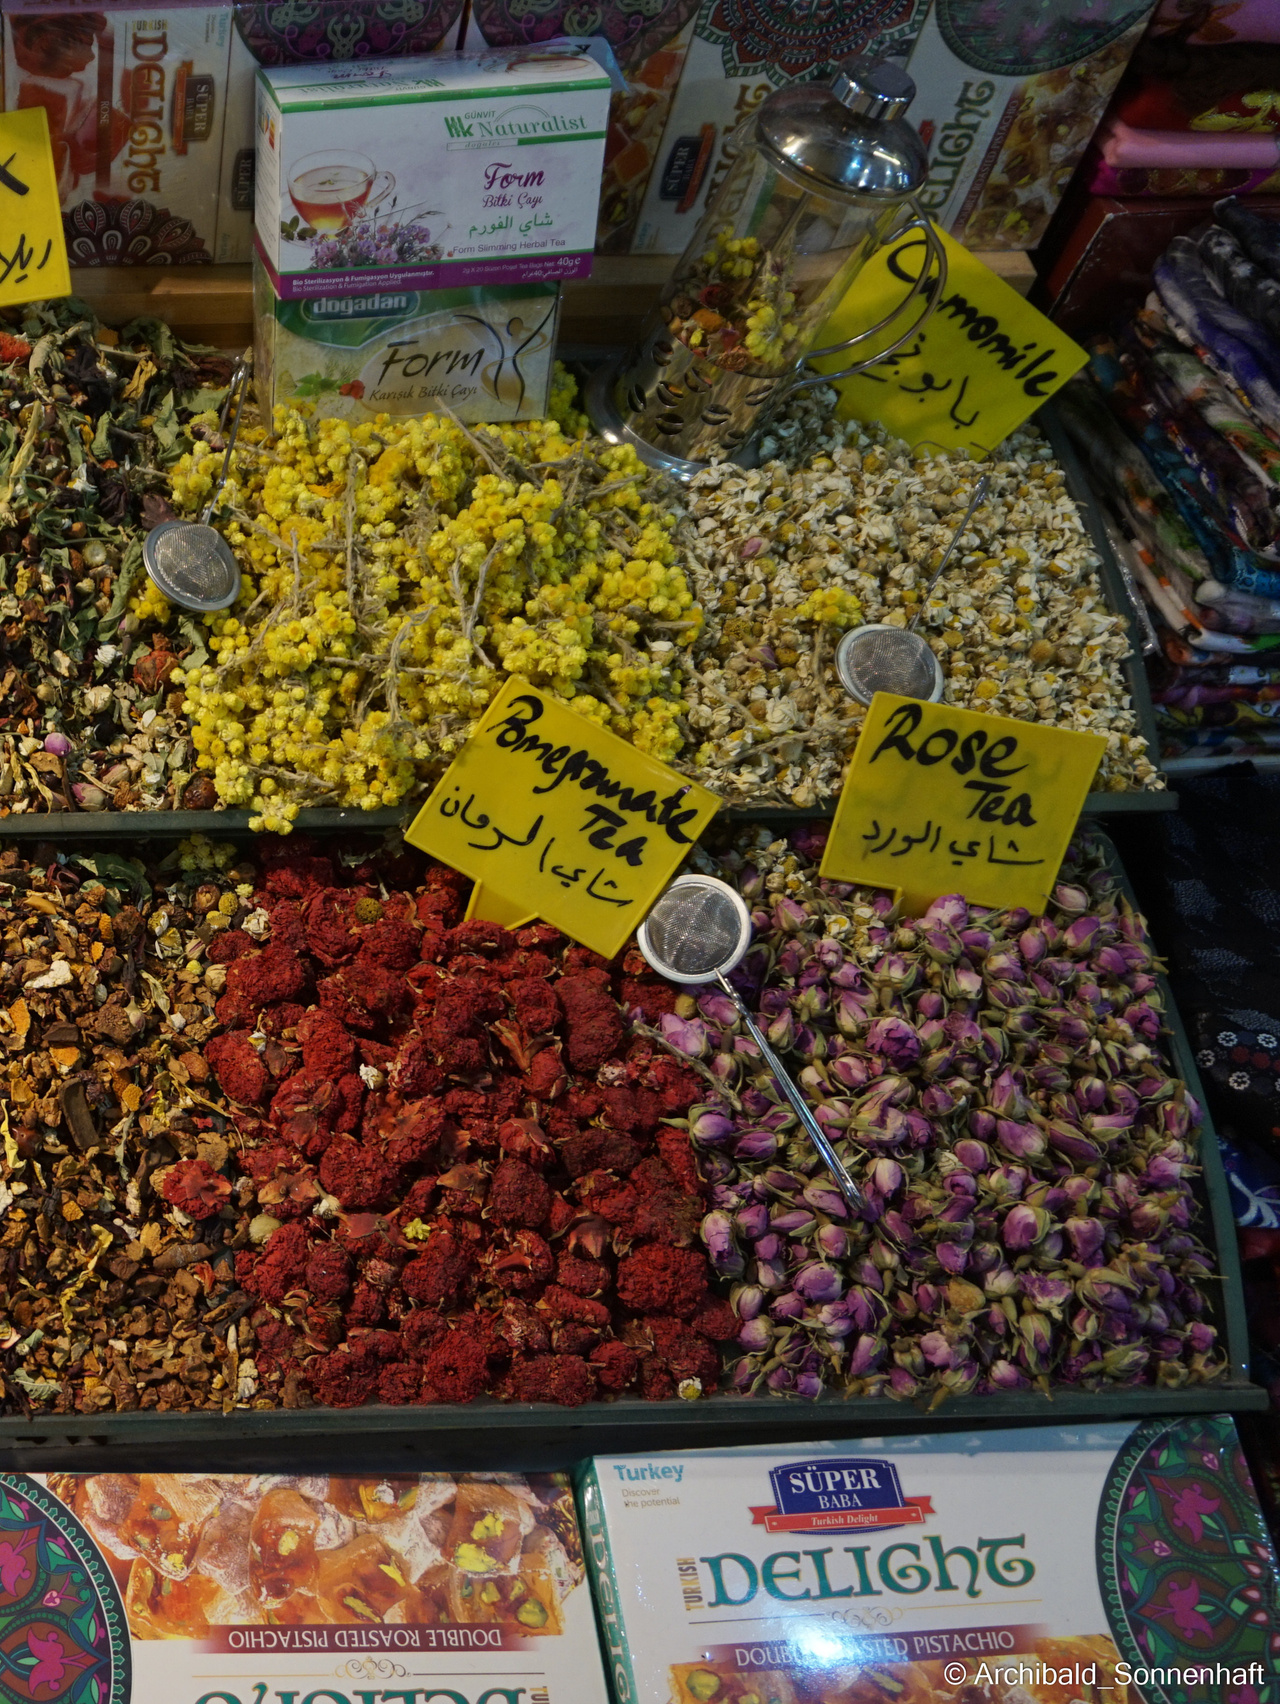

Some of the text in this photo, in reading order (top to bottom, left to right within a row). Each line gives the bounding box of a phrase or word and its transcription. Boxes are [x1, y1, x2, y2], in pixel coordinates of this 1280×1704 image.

[99, 100, 110, 126] ROSE
[193, 83, 213, 132] SÜPER
[464, 109, 497, 120] GÜNVİT
[477, 114, 588, 138] Naturalist
[991, 100, 1019, 150] PISTACHIO
[484, 162, 546, 191] Form
[482, 193, 513, 209] Bitki
[469, 211, 554, 239] شاي الفورم
[452, 238, 566, 254] Form Slimming Herbal Tea
[303, 283, 338, 292] Sterilization
[343, 280, 378, 289] Fumigation
[304, 277, 344, 285] Sterilizasyon
[351, 273, 389, 283] Fumigasyon
[377, 340, 486, 386] Form
[369, 384, 478, 401] Karışık Bitki Çayı
[869, 703, 1030, 779] Rose
[963, 779, 1038, 828] Tea
[578, 803, 649, 867] Tea
[862, 819, 1046, 866] شاي الورد
[613, 1463, 685, 1482] Turkey
[789, 1465, 883, 1495] SÜPER
[622, 1487, 661, 1498] Discover
[640, 1496, 681, 1509] potential
[818, 1493, 864, 1510] BABA
[811, 1513, 879, 1527] Turkish Delight
[676, 1556, 706, 1612] TURKISH
[228, 1628, 503, 1649] DOUBLE ROASTED PISTACHIO
[914, 1630, 1016, 1656] PISTACHIO
